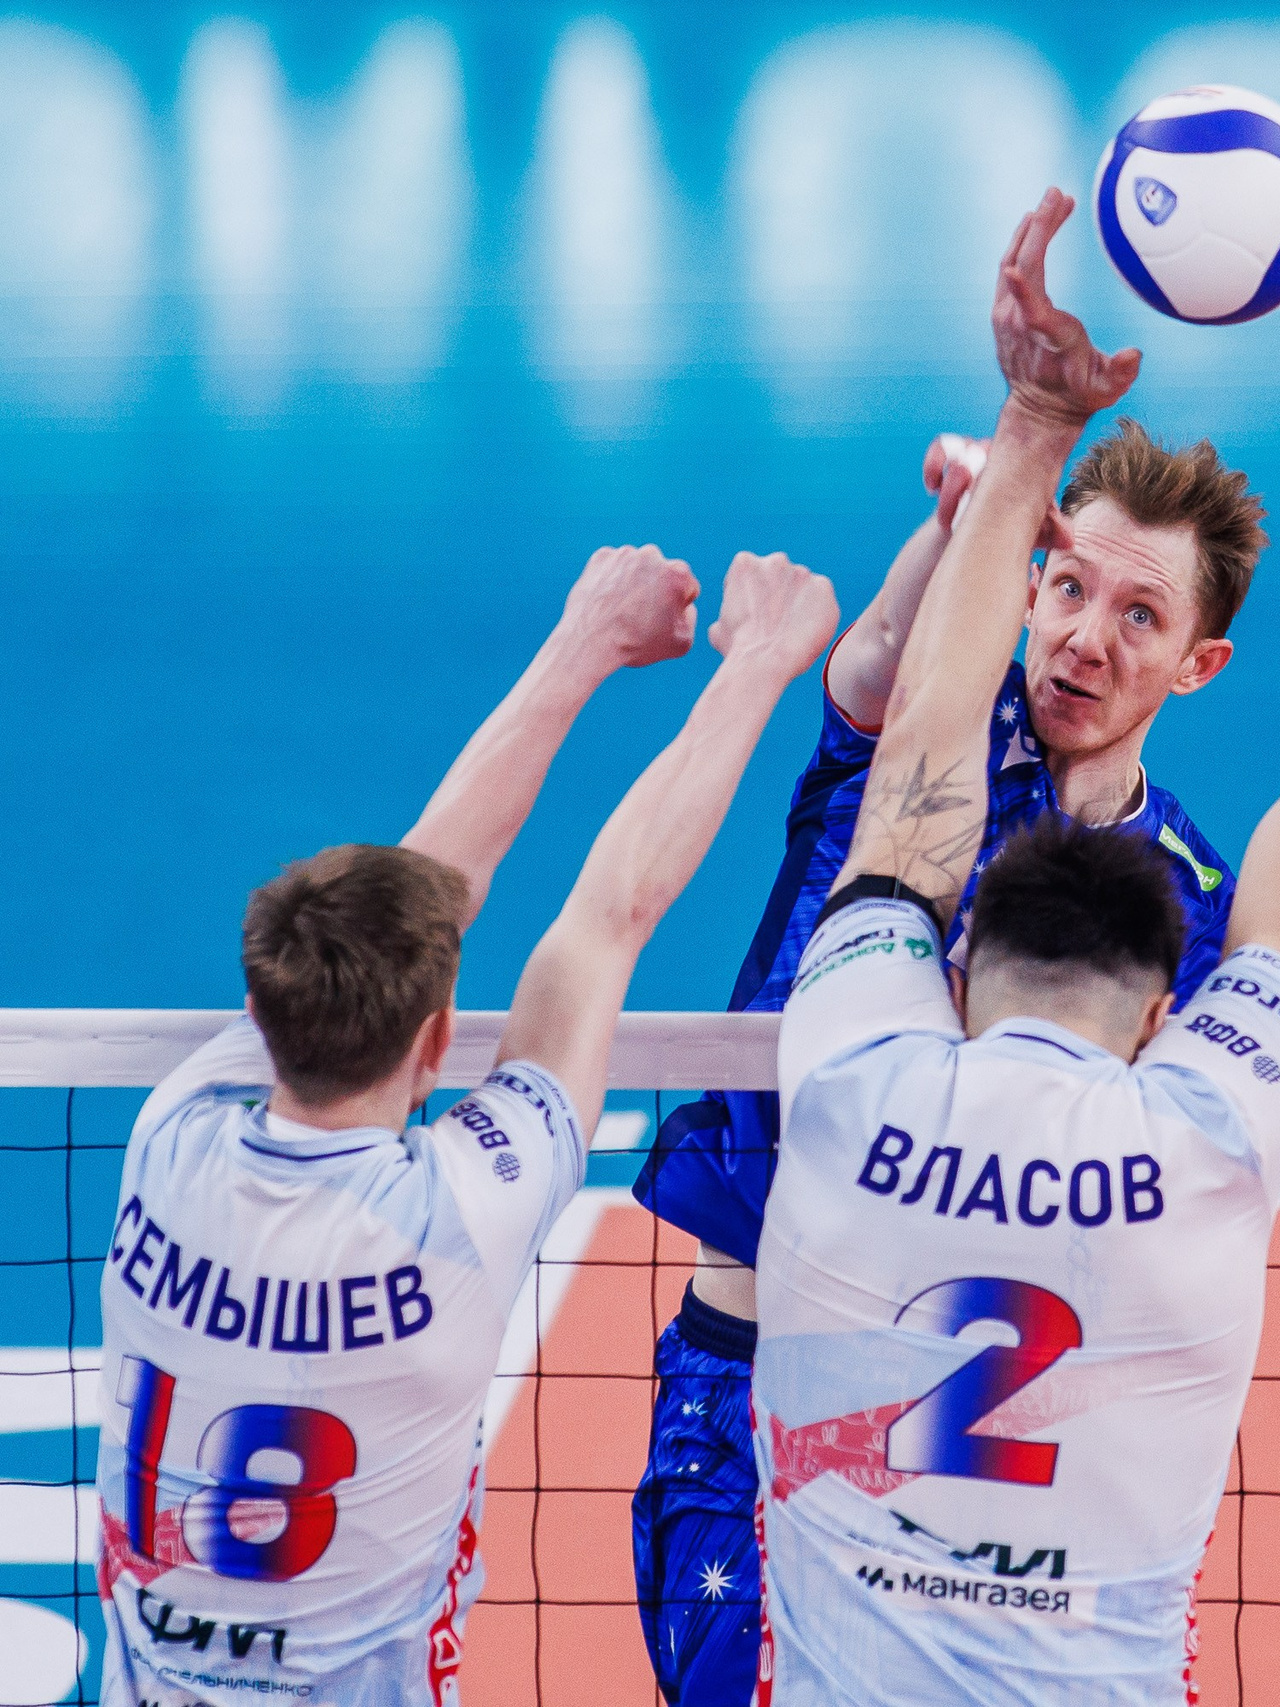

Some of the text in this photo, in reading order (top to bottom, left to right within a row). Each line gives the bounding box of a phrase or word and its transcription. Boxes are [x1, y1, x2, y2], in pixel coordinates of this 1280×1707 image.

[856, 1123, 1165, 1228] ВЛАСОВ
[110, 1194, 434, 1354] СЕМЫШЕВ
[885, 1276, 1083, 1487] 2
[115, 1354, 358, 1583] 18
[902, 1572, 1071, 1615] мангазея
